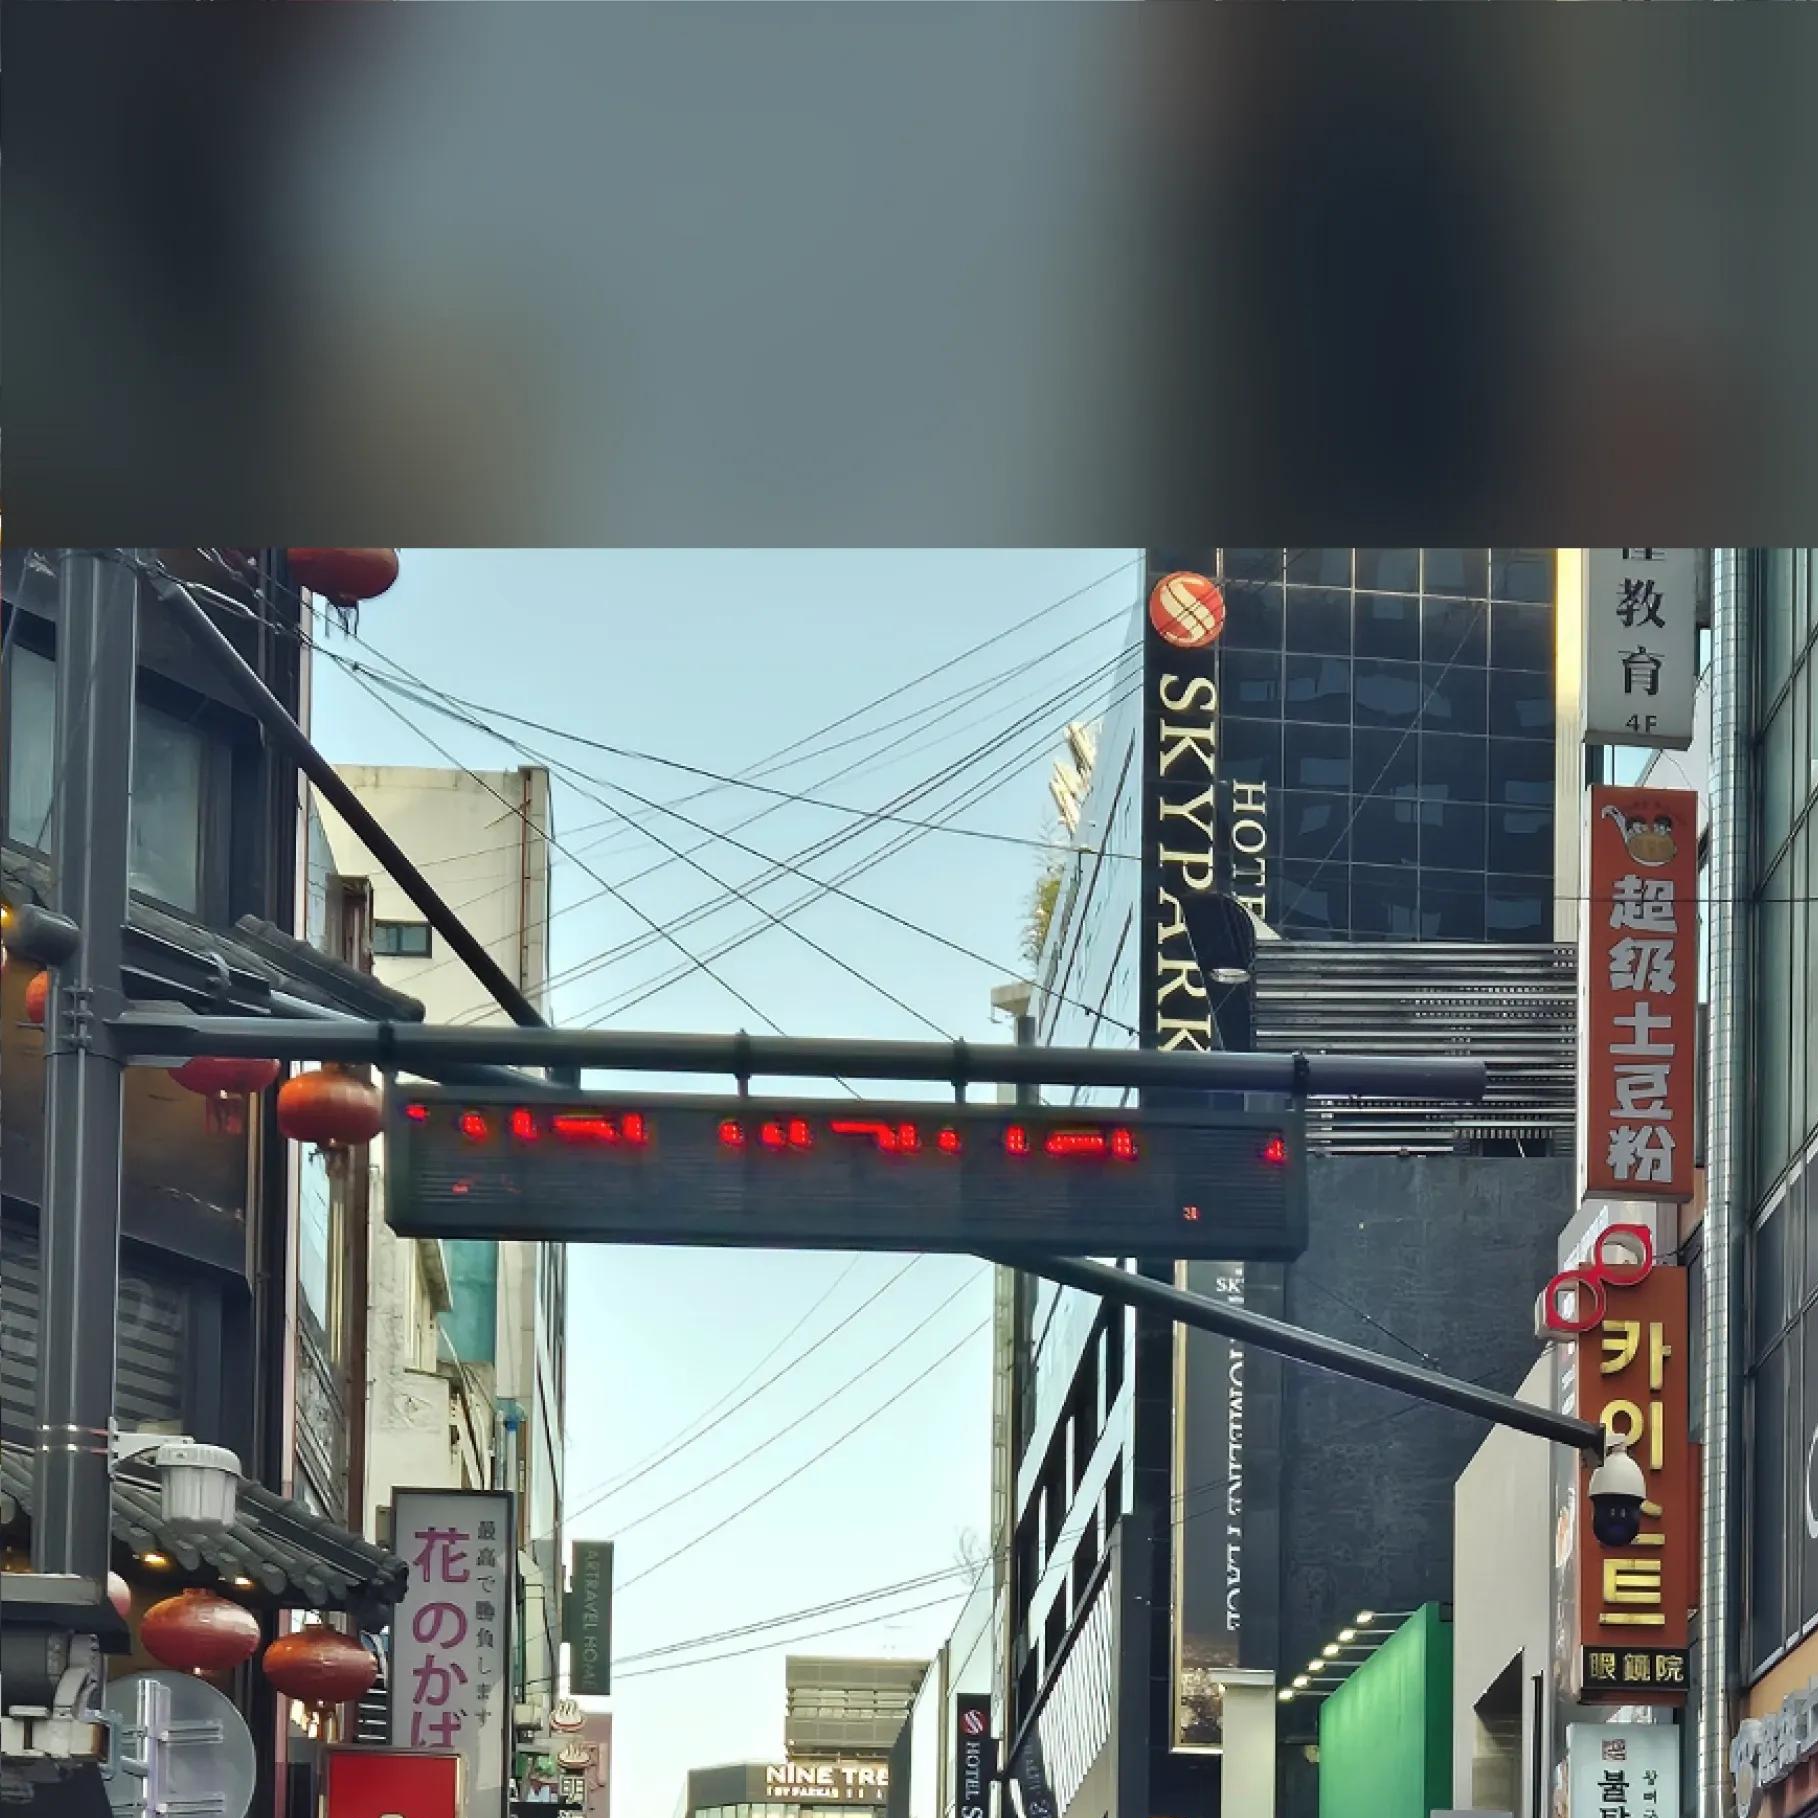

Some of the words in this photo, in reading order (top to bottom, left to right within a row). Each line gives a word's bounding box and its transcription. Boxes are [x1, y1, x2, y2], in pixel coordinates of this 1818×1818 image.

[1615, 548, 1668, 696] 教育
[1626, 714, 1658, 733] 4F
[1157, 674, 1218, 1052] SKYPARK
[1232, 779, 1268, 920] HOTE
[1606, 873, 1679, 1183] 超级土豆粉
[766, 1762, 834, 1784] NINE
[965, 1742, 982, 1800] HOTEL
